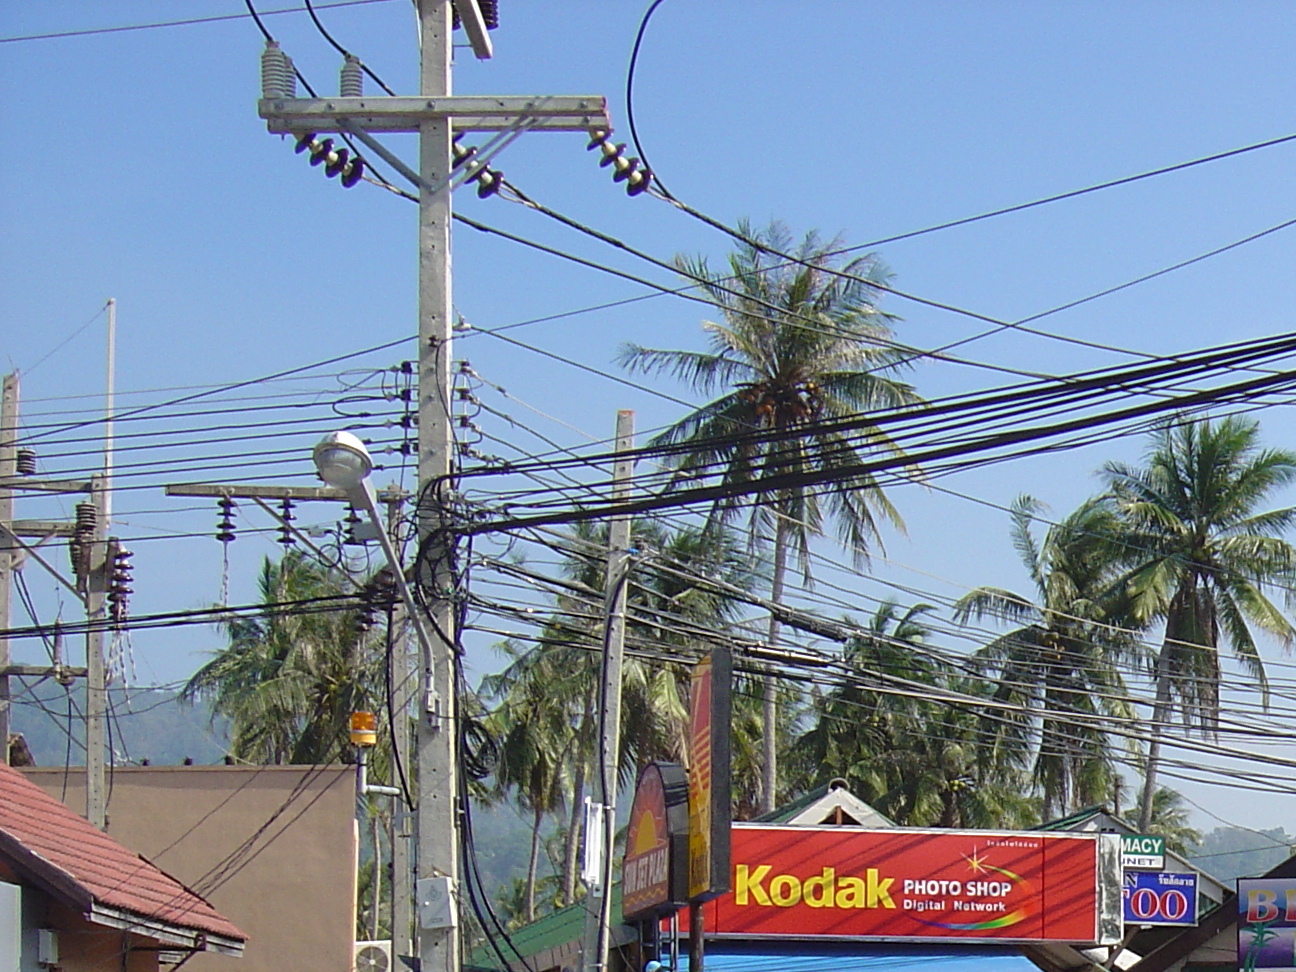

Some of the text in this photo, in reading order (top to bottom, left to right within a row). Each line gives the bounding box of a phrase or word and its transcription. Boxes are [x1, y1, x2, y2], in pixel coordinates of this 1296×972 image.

[624, 860, 637, 895] SUN
[637, 856, 648, 890] SET
[648, 847, 668, 885] PLAZA
[735, 864, 897, 909] Kodak
[904, 880, 1012, 897] PHOTO SHOP
[903, 899, 1006, 912] Digital Network
